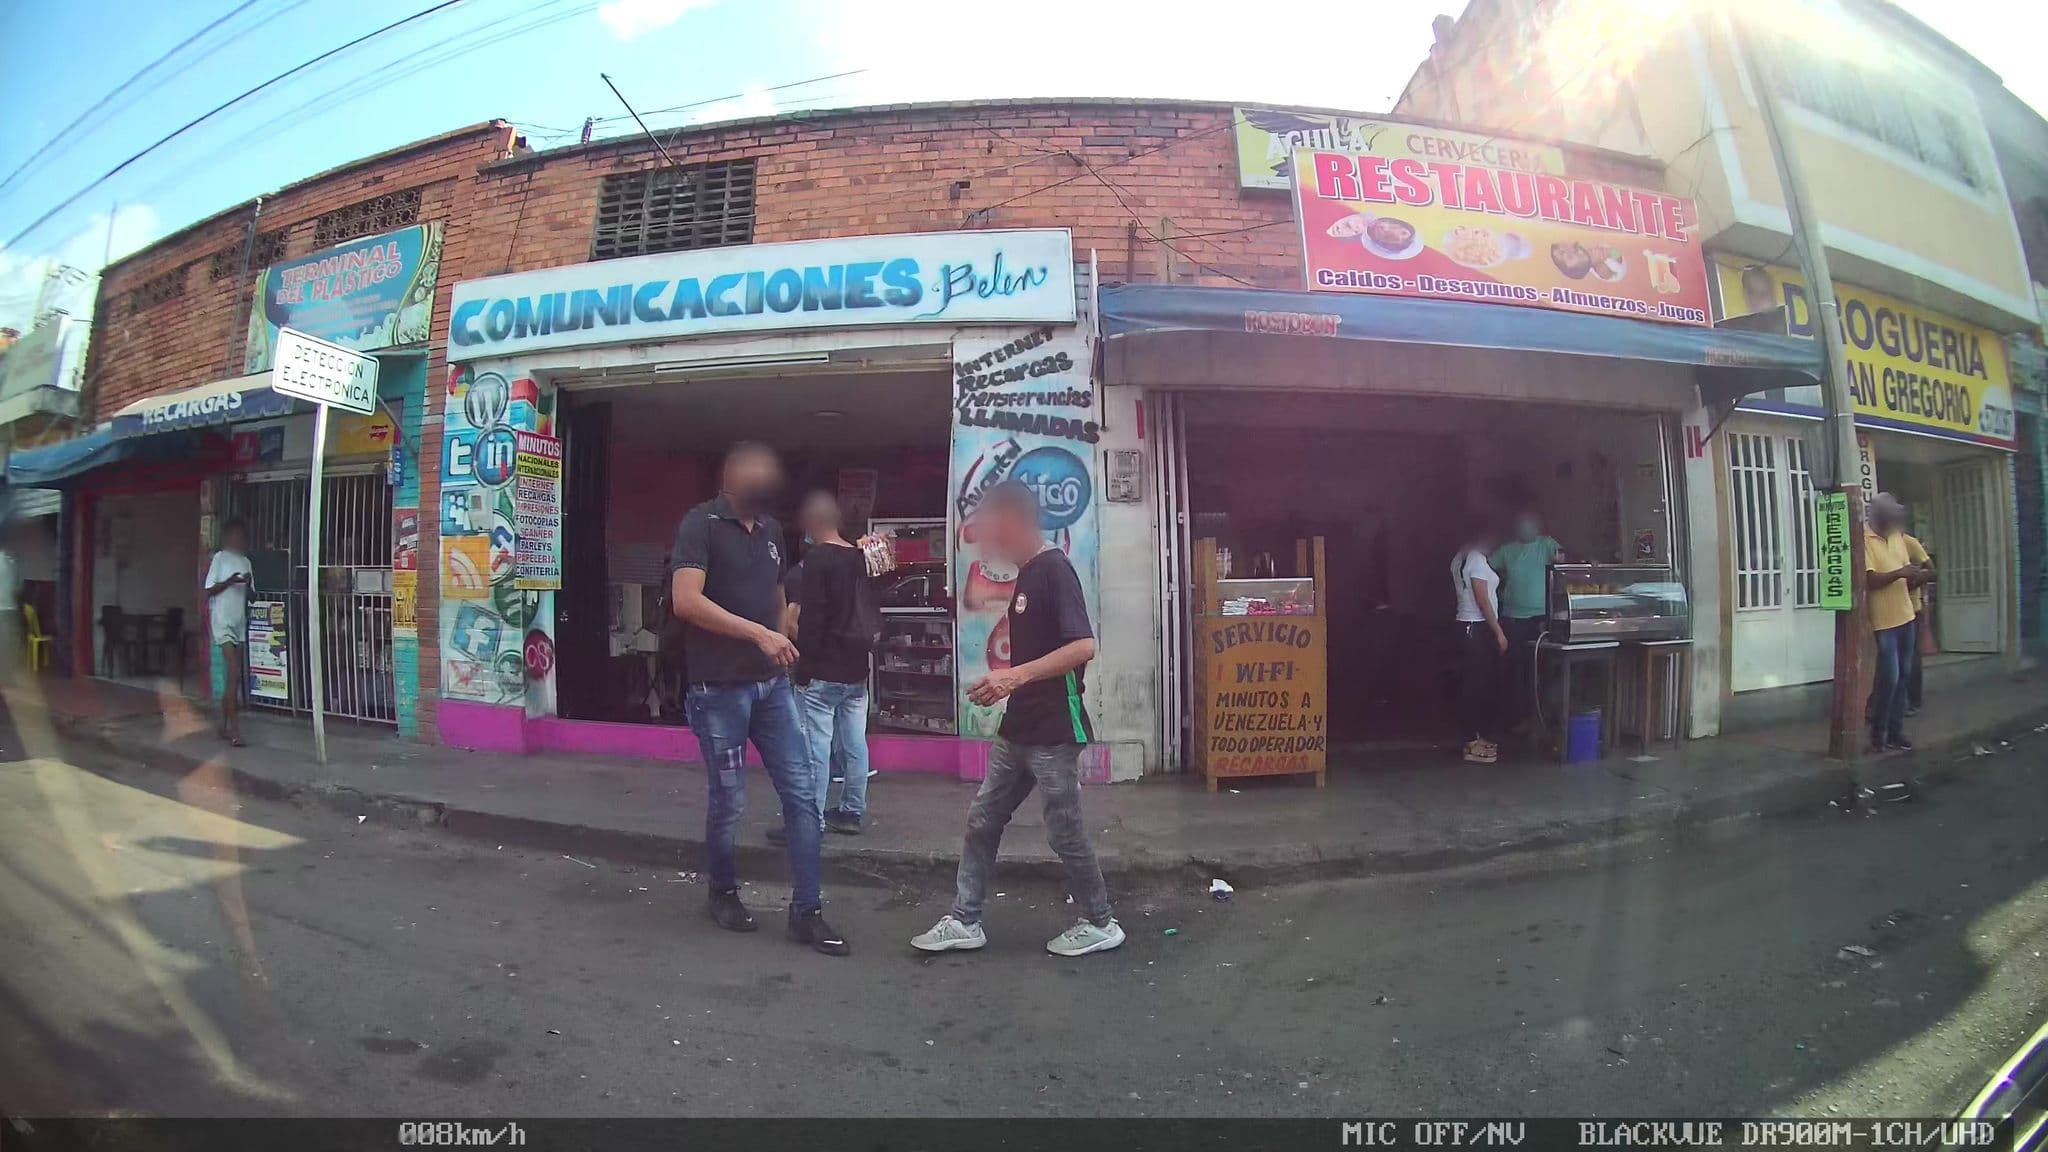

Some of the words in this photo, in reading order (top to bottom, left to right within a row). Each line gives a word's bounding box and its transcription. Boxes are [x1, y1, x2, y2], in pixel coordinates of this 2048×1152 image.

[1312, 151, 1688, 242] RESTAURANTE
[281, 241, 402, 288] TERMINAL
[275, 285, 304, 305] DEL
[311, 260, 402, 301] PLASTICO
[1316, 268, 1402, 290] Caldos
[1417, 275, 1539, 302] Desayunos
[1551, 287, 1648, 315] Almuerzos
[1657, 302, 1706, 324] Jugos
[451, 257, 923, 347] COMUNICACIONES
[912, 251, 1048, 320] Belen
[294, 343, 364, 379] DETECCION
[282, 365, 370, 404] ELECTRONICA
[1846, 359, 1878, 407] AN
[1882, 366, 1972, 426] GREGORIO
[141, 391, 243, 425] RECARGAS
[958, 406, 1100, 444] LLAMADAS
[518, 433, 561, 457] MINUTOS
[518, 454, 560, 469] NACIONALES
[518, 487, 556, 503] RECARGAS
[519, 477, 555, 491] INTERNET
[516, 501, 559, 515] IMPRESIONES
[516, 514, 559, 528] FOTOCOPIAS
[520, 527, 554, 539] SCANNER
[521, 540, 552, 552] PARLEYS
[516, 551, 556, 564] PAPELERIA
[1826, 512, 1844, 598] RECARGAS
[516, 565, 560, 577] CONFITERIA
[1211, 621, 1312, 654] SERVICIO
[1215, 690, 1290, 709] MINUTOS
[1301, 692, 1312, 709] A
[1214, 712, 1307, 732] VENEZUELA
